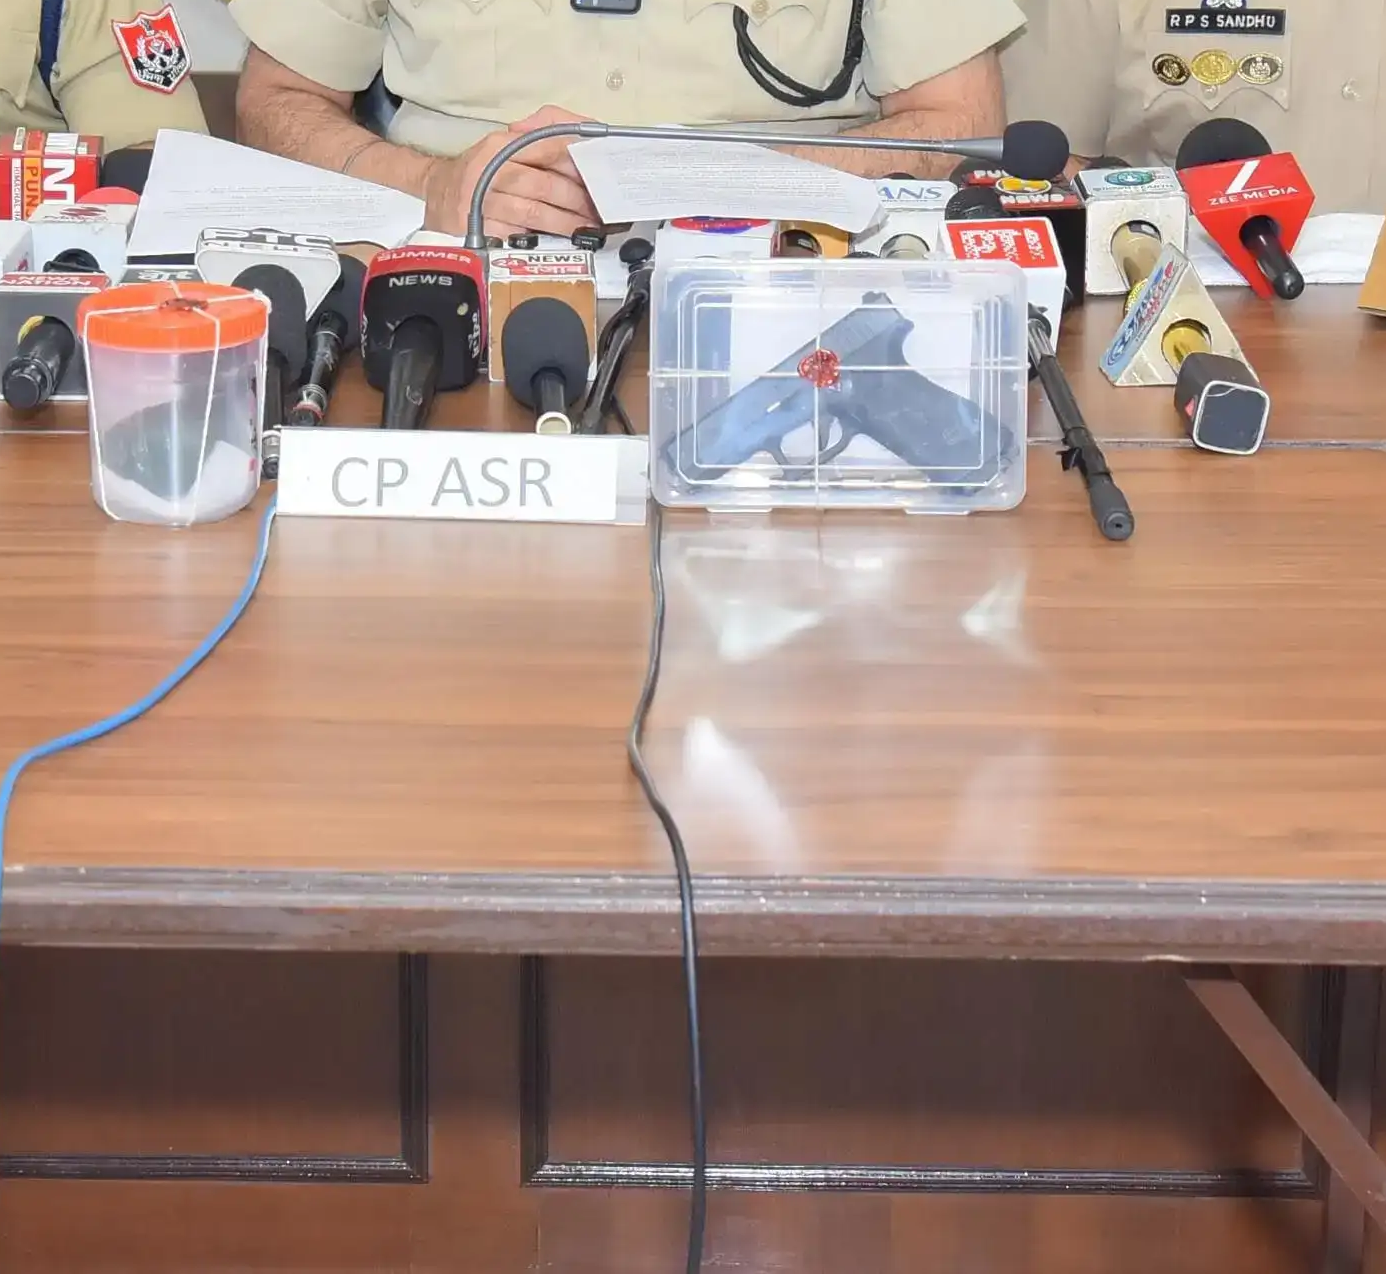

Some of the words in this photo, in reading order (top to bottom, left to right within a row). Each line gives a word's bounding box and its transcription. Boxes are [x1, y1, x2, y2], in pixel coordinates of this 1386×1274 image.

[1216, 14, 1275, 28] SANDHU
[877, 185, 943, 200] ANS
[1209, 194, 1240, 207] ZEE
[1243, 186, 1298, 200] MEDIA
[203, 227, 332, 247] PTC
[377, 249, 472, 264] SUMMER
[528, 253, 584, 263] NEWS
[389, 274, 453, 287] NEWS
[331, 457, 409, 507] CP
[431, 457, 553, 507] ASR
